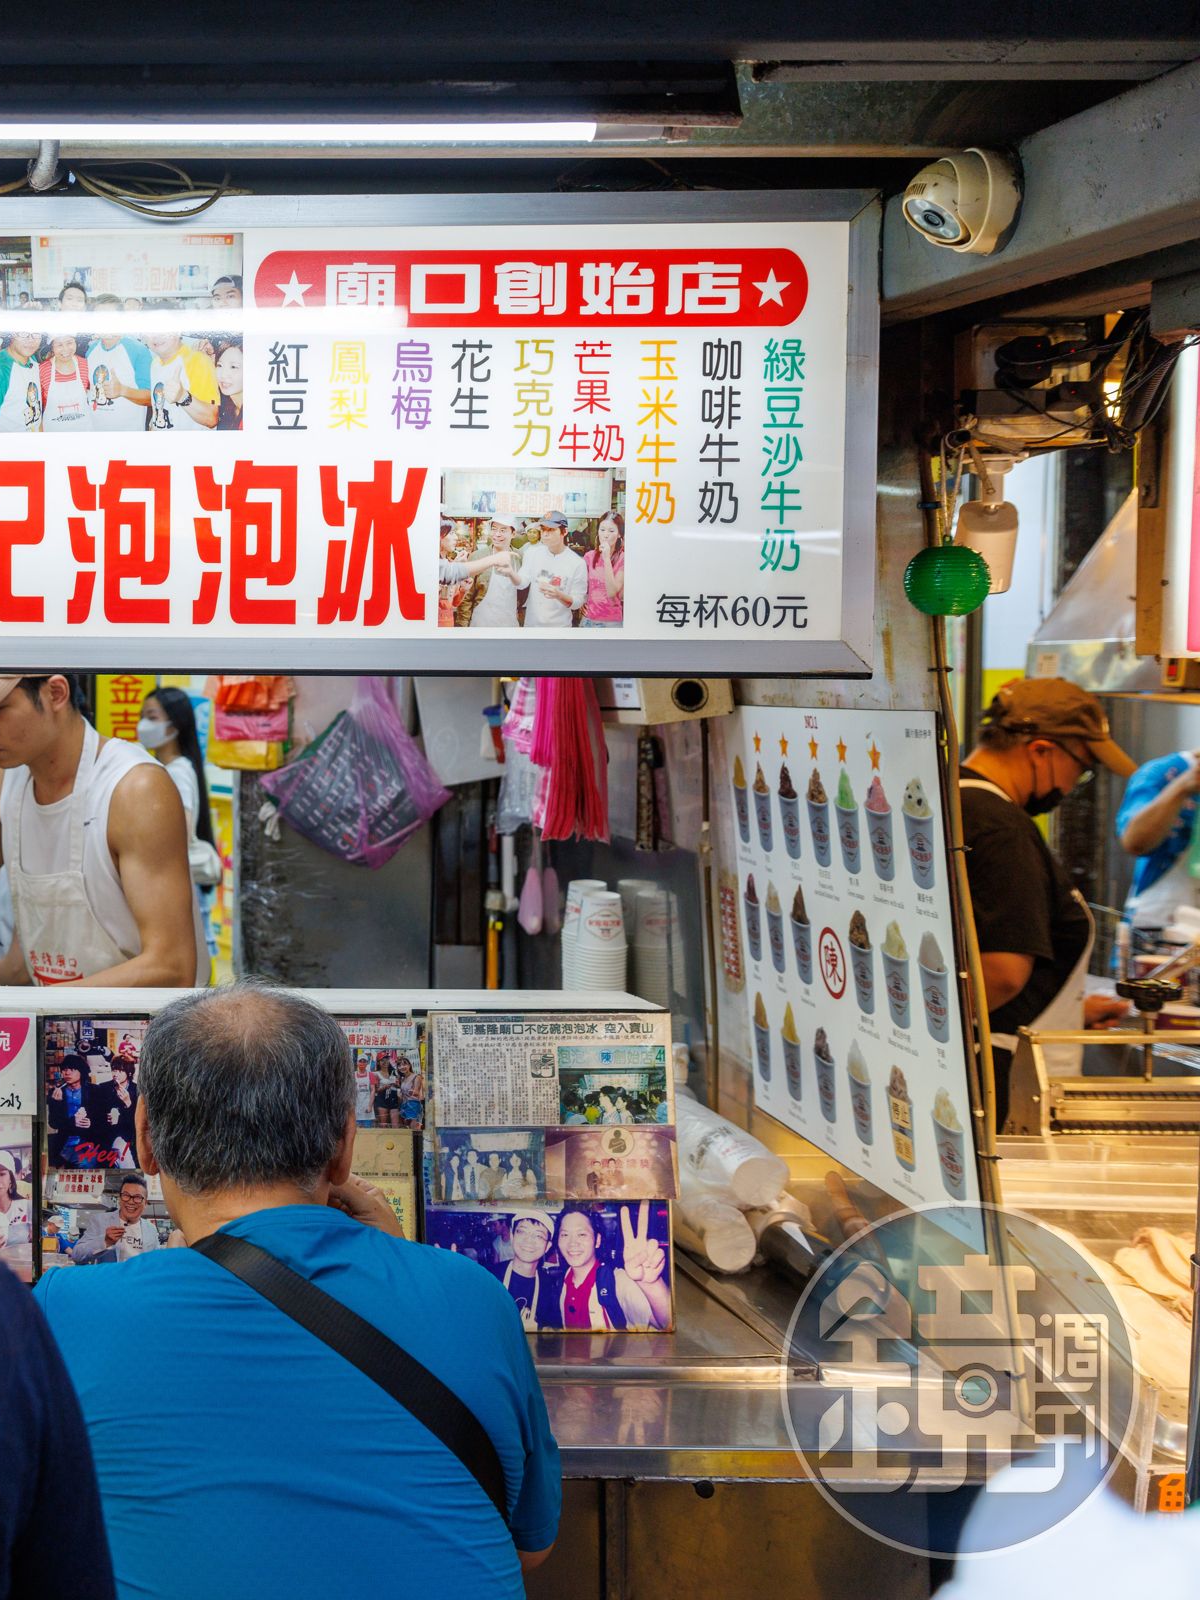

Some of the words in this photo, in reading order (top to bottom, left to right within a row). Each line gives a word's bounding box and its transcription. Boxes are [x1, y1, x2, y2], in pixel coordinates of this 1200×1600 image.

[325, 262, 742, 315] 廟口創始店
[268, 341, 308, 430] 紅豆
[330, 341, 370, 431] 鳳梨
[392, 339, 433, 429] 烏梅
[450, 339, 492, 429] 花生
[513, 339, 554, 457] 巧克力
[573, 340, 612, 414] 芒果
[559, 424, 624, 462] 牛奶
[635, 340, 678, 524] 玉米牛奶
[698, 338, 742, 524] 咖啡牛奶
[760, 338, 805, 572] 綠豆沙牛奶
[656, 594, 808, 628] 每杯60元
[75, 1140, 131, 1168] Hey!
